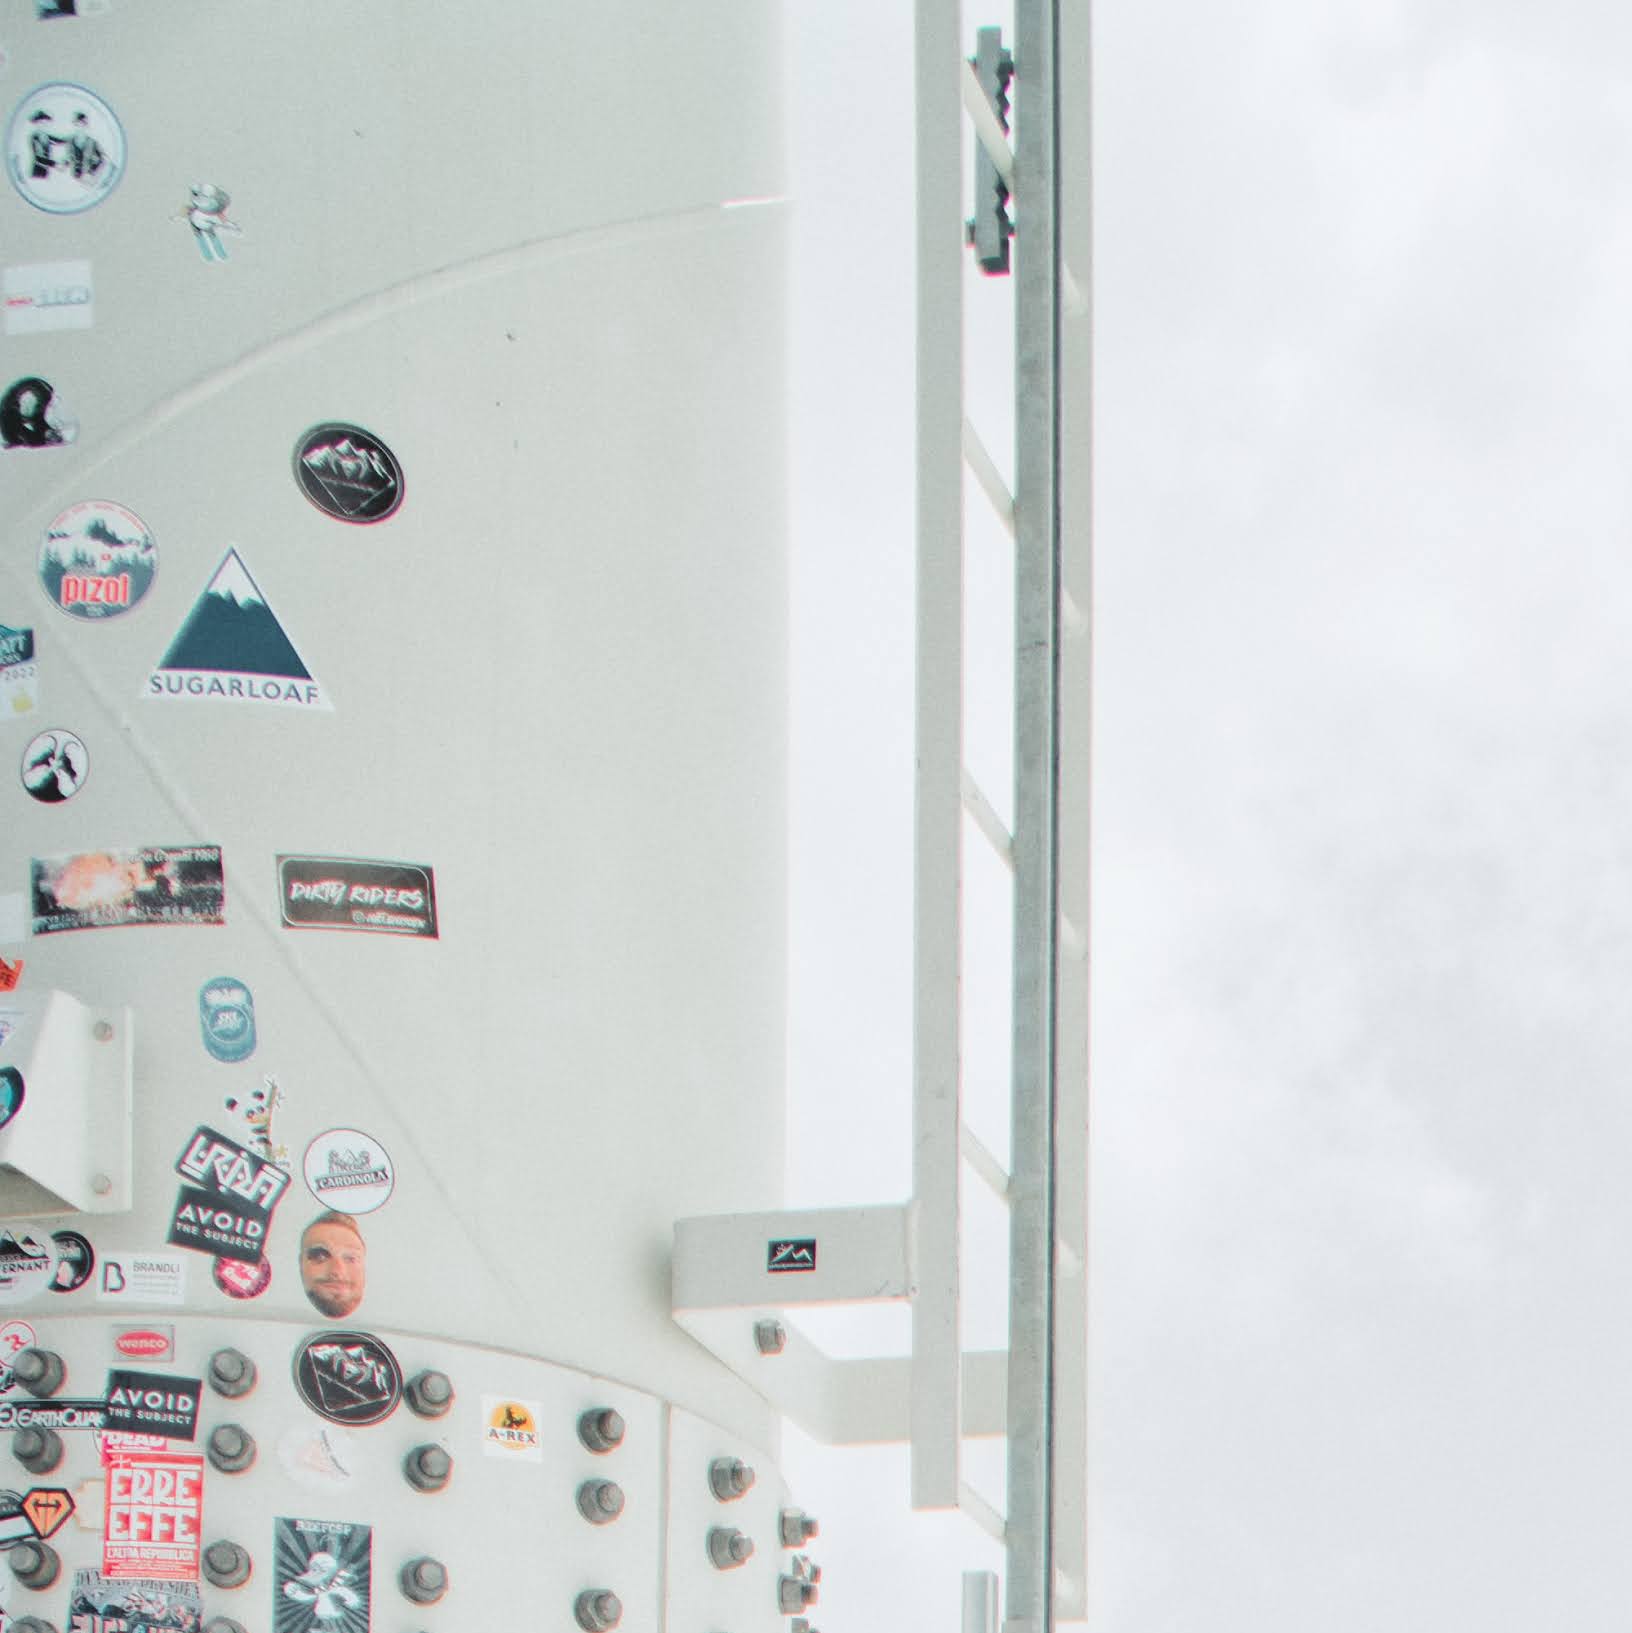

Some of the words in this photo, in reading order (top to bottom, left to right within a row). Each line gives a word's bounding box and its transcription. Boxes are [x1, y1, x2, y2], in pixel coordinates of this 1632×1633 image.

[149, 674, 320, 704] SUGARLOAF
[349, 884, 424, 908] RIDERS
[319, 1167, 389, 1190] CARDINOLA
[180, 1205, 263, 1238] AVOID
[175, 1223, 200, 1237] THE
[203, 1227, 260, 1249] SUBJECT
[1, 1260, 51, 1272] ERNANT
[117, 1337, 167, 1350] wenco
[109, 1386, 195, 1410] AVOID
[108, 1406, 133, 1420] THE
[135, 1409, 193, 1425] SUBJECT
[110, 1469, 198, 1505] ERRE
[108, 1509, 197, 1544] EFFE
